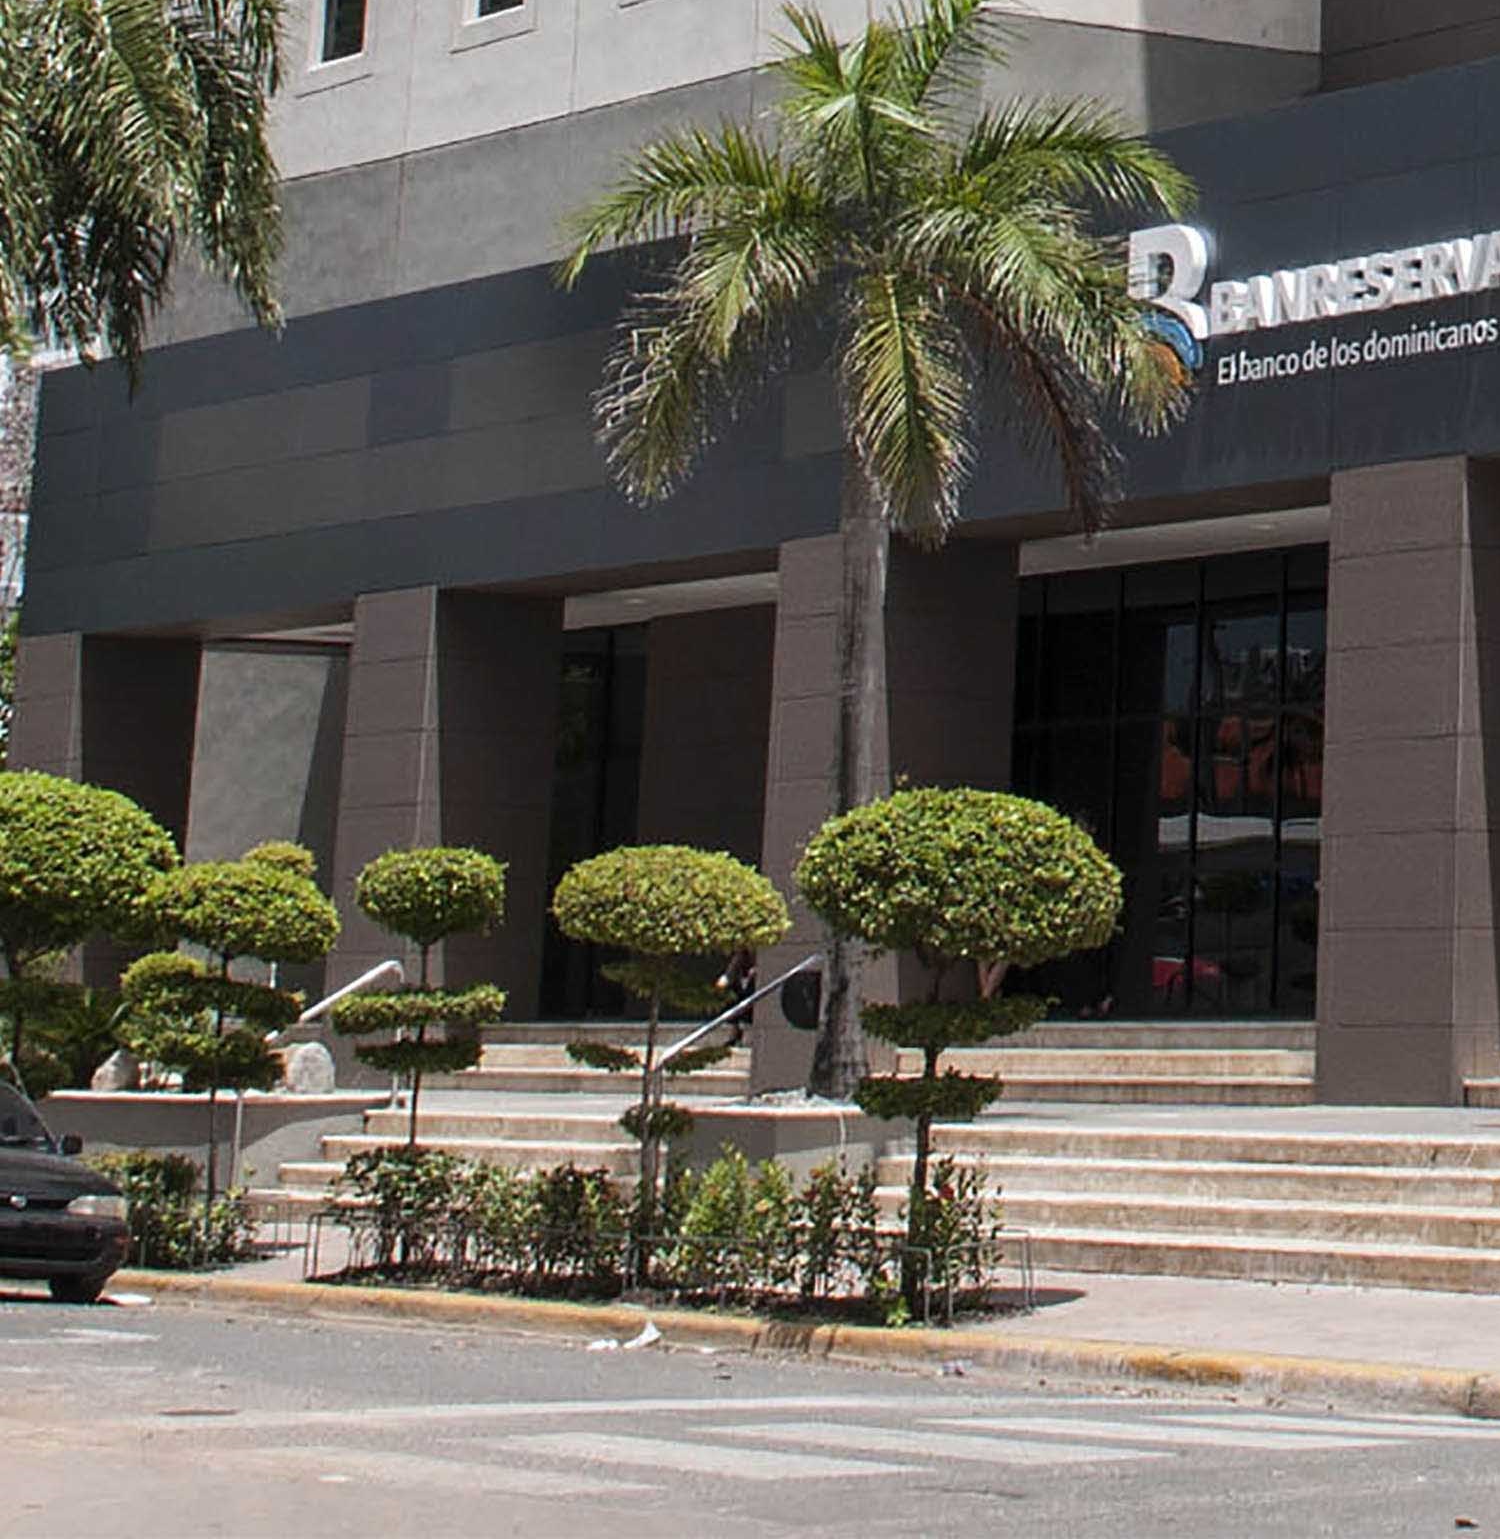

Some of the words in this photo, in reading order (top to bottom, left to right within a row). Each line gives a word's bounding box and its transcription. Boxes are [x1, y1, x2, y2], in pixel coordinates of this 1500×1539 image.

[1217, 353, 1237, 385] El
[1239, 349, 1300, 382] banco
[1302, 339, 1329, 371] de
[1331, 336, 1361, 367] los
[1363, 316, 1499, 363] dominicanos
